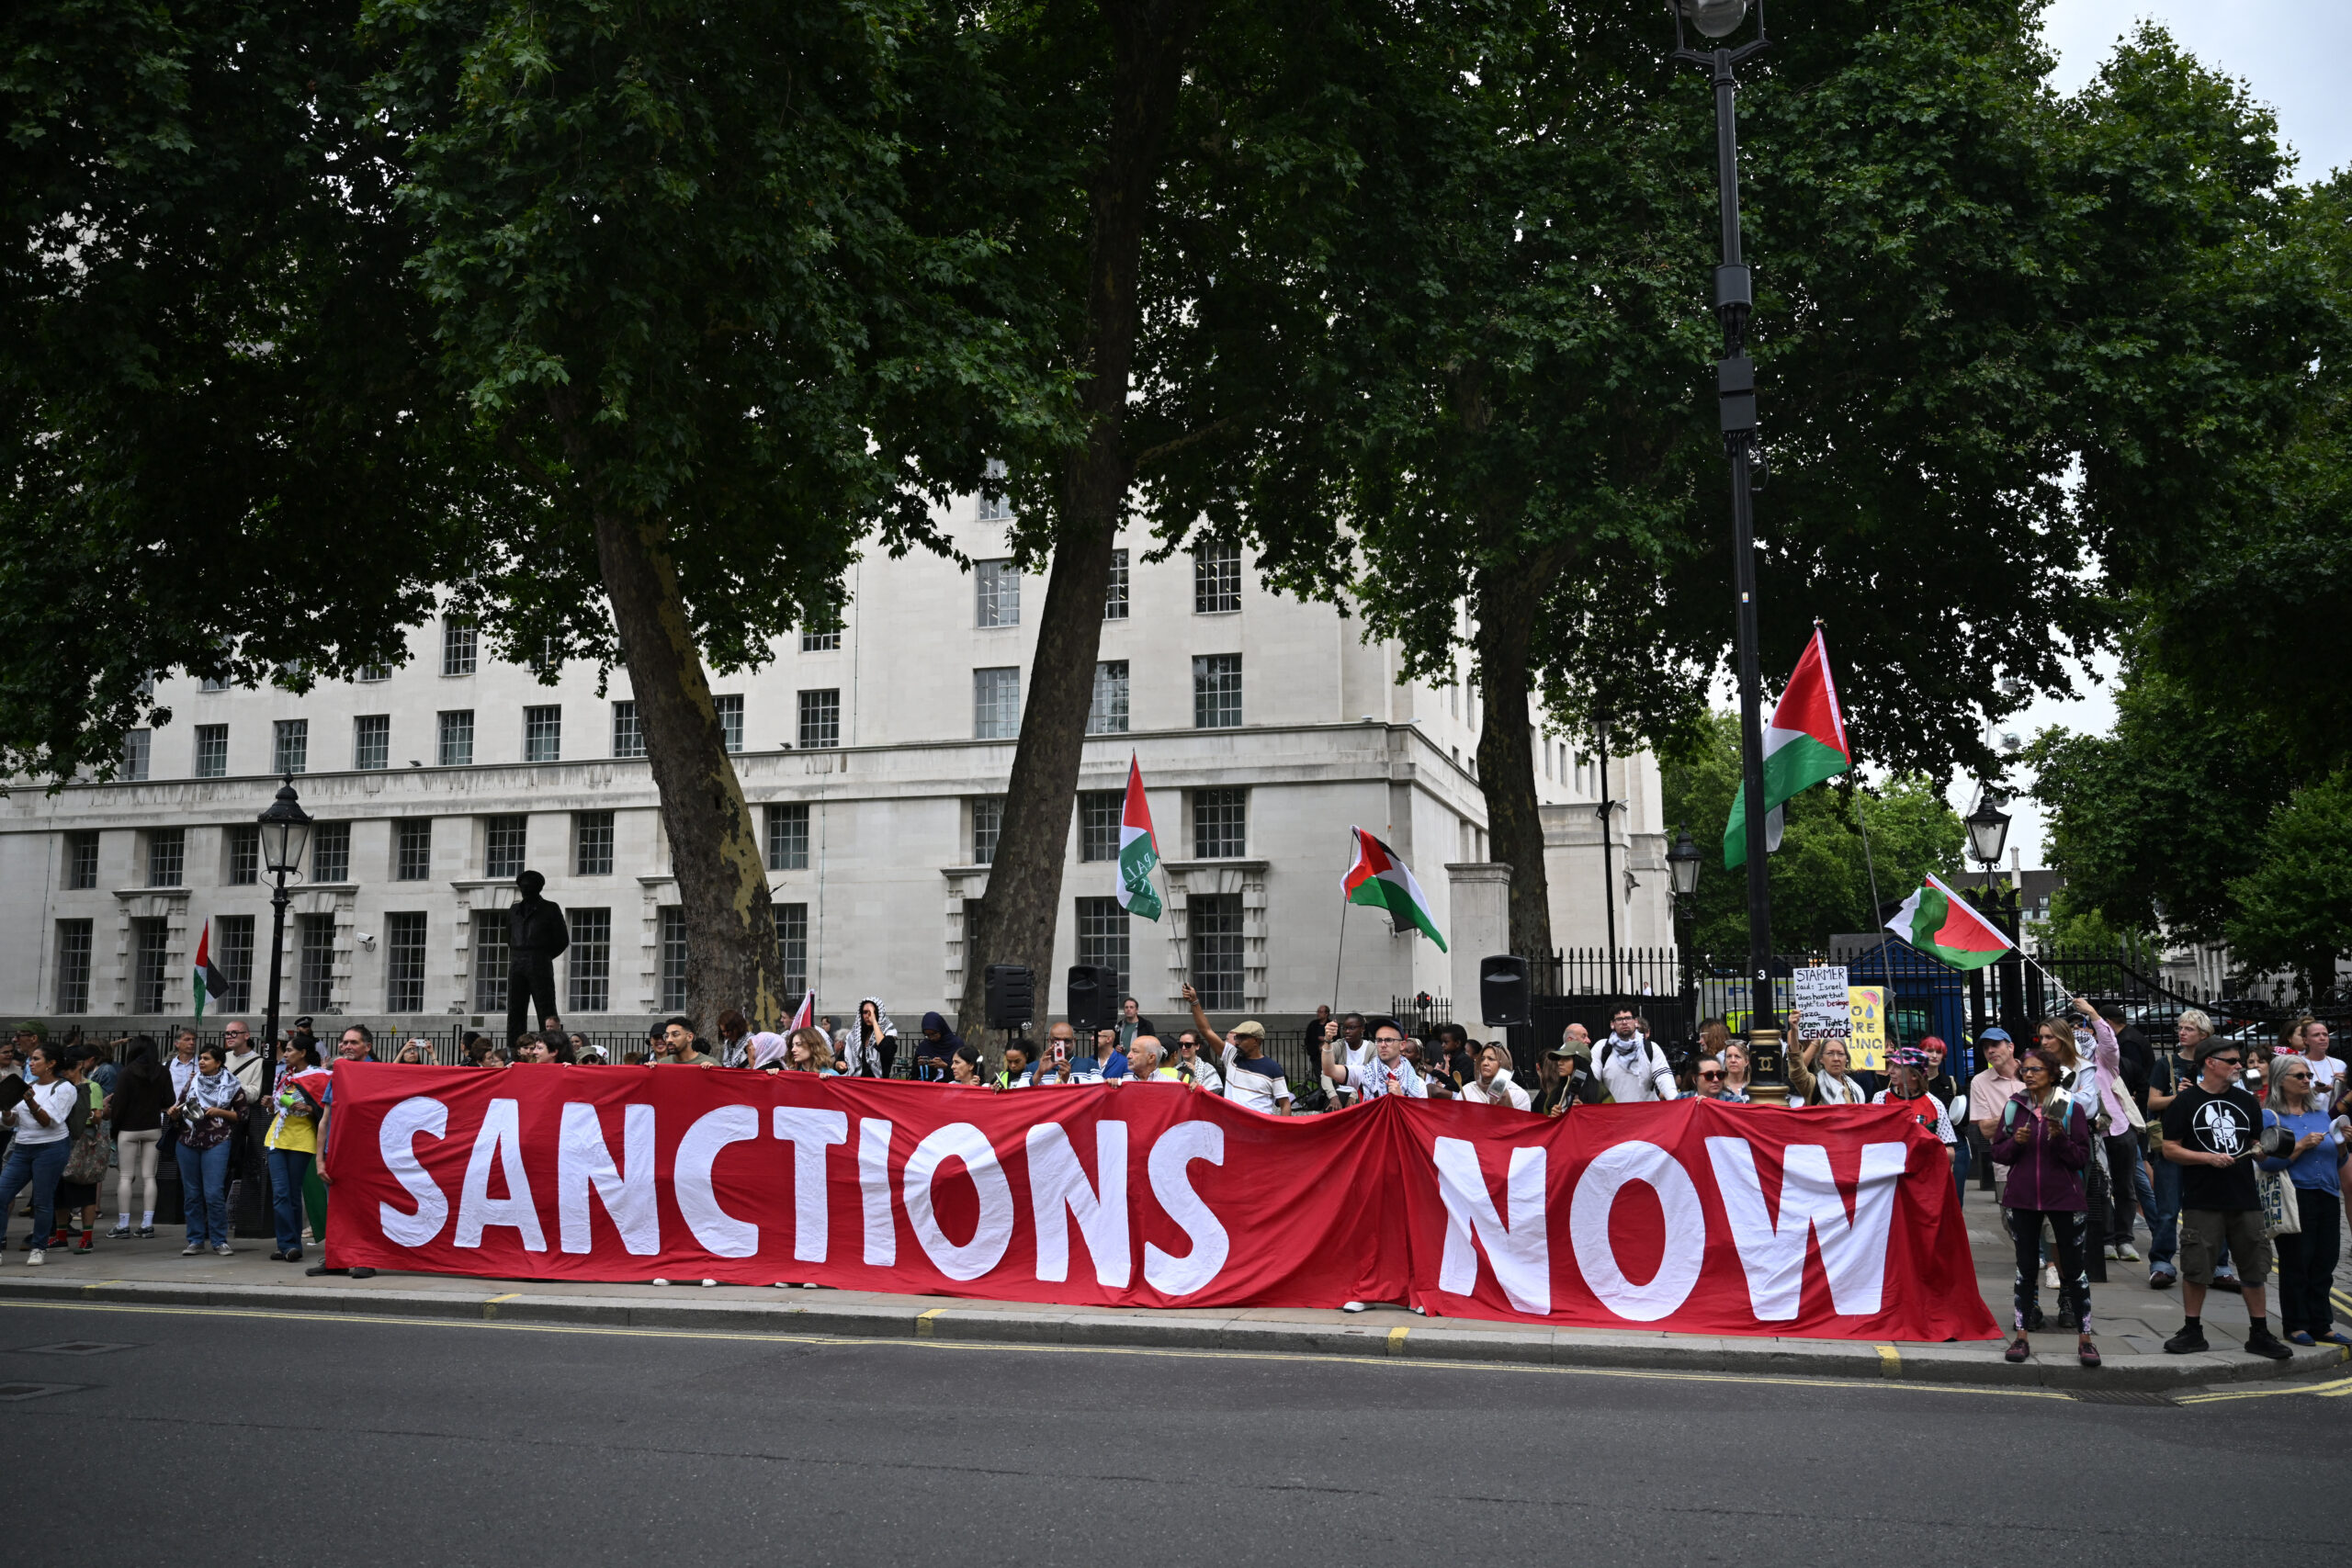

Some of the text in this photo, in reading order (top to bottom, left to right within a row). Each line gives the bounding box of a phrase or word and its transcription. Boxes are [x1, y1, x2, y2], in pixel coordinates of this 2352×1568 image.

[1758, 970, 1766, 980] 3
[1796, 968, 1845, 982] STARMER
[1817, 982, 1843, 991] Israel
[1851, 1006, 1862, 1016] O
[1798, 1021, 1820, 1031] green
[1825, 1018, 1843, 1027] light
[1802, 1028, 1851, 1039] GENOCIDE
[1849, 1038, 1883, 1050] LING
[379, 1096, 1907, 1322] SANCTIONS NOW
